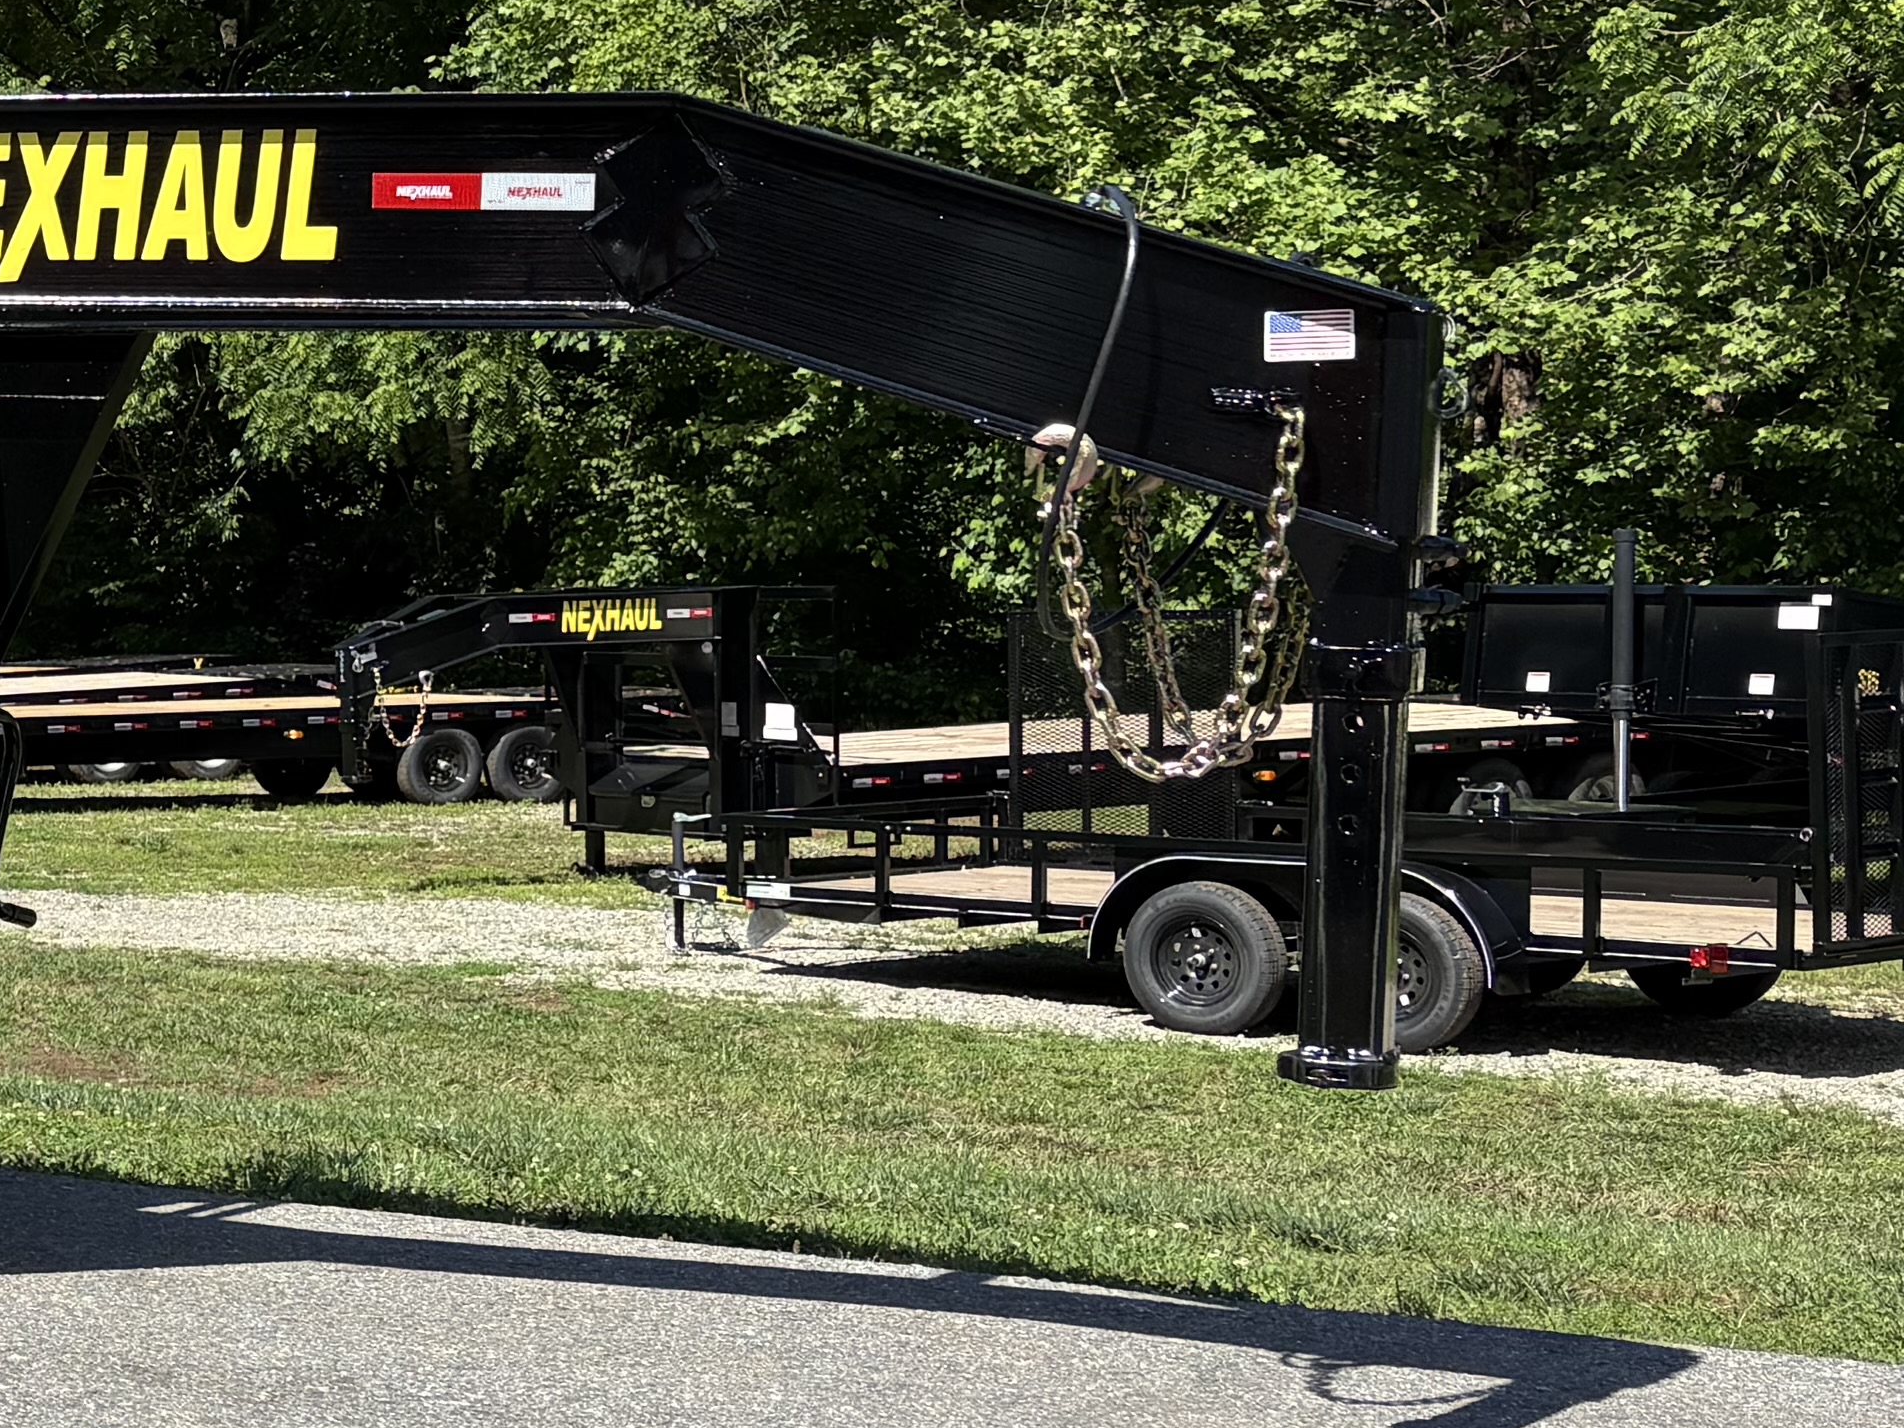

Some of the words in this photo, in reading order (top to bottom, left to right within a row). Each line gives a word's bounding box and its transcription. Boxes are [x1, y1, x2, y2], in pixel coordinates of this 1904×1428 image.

[395, 185, 453, 200] NEXHAUL
[507, 186, 563, 200] NEXHAUL
[561, 597, 662, 641] NEXHAUL
